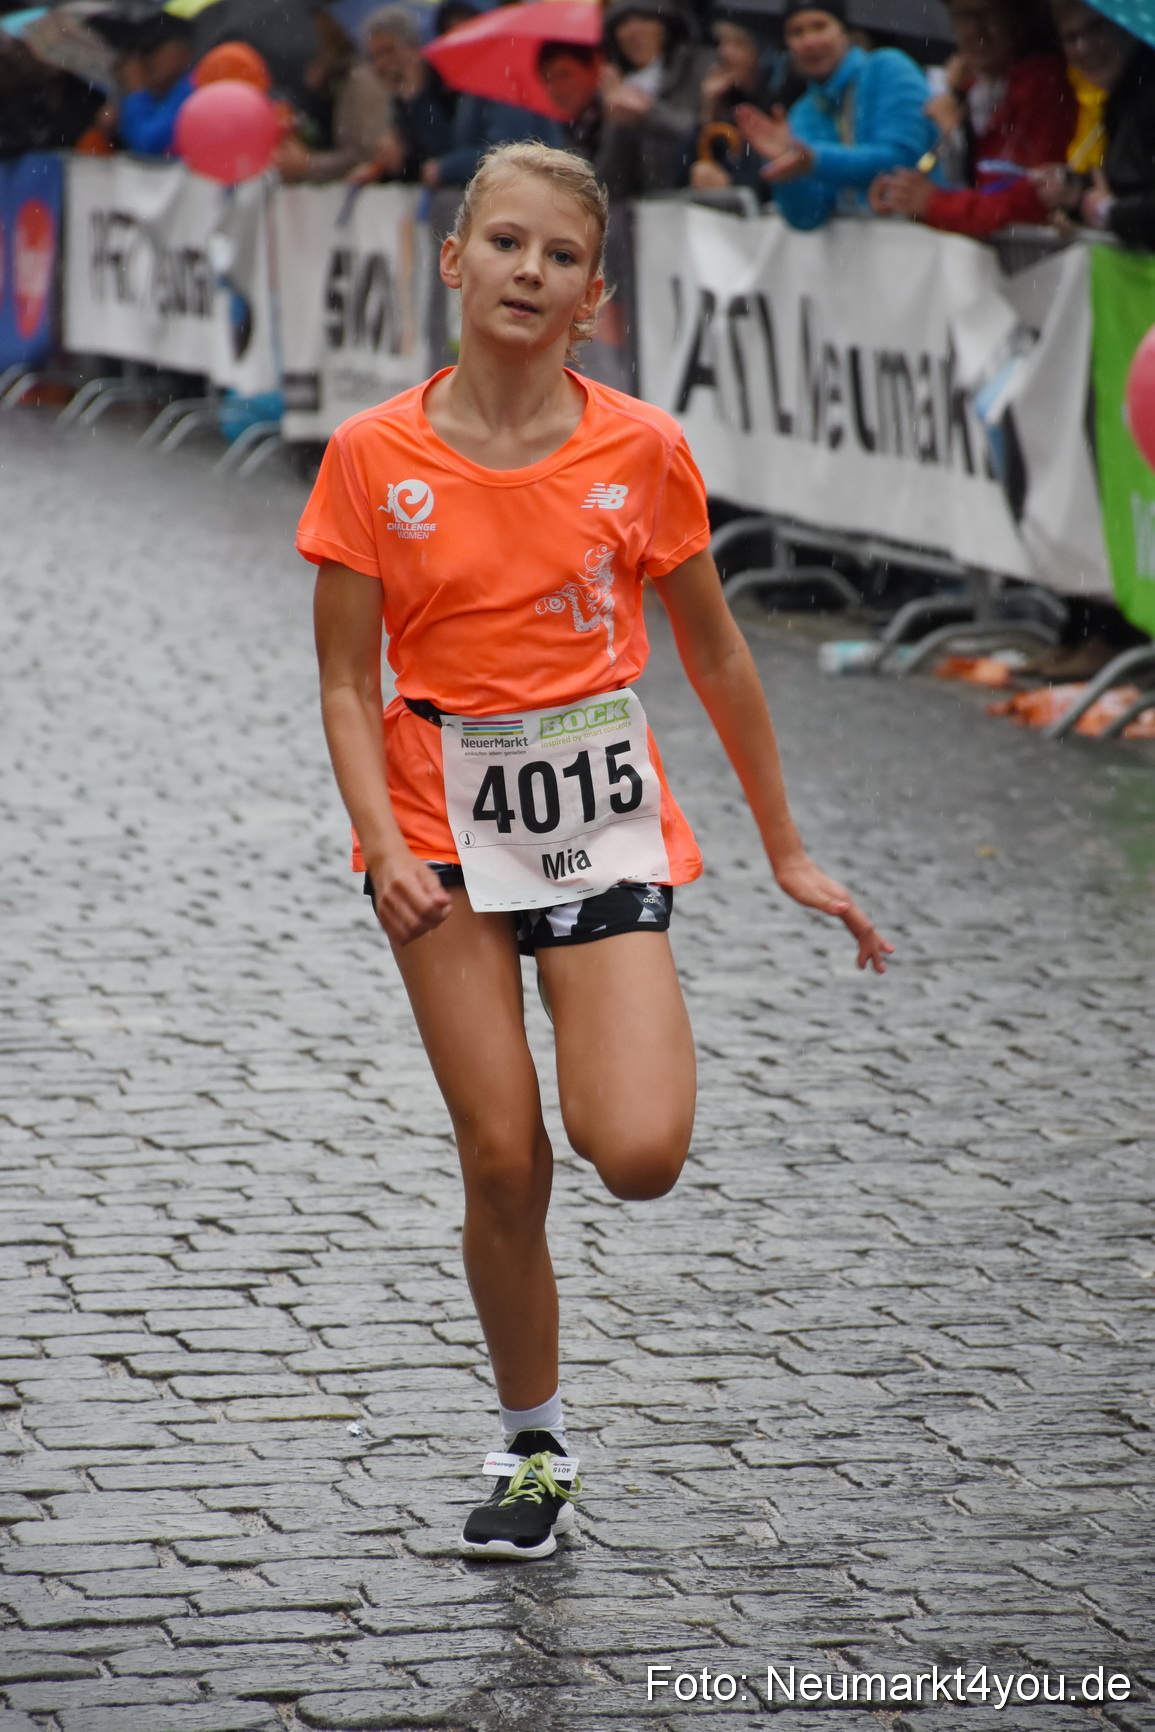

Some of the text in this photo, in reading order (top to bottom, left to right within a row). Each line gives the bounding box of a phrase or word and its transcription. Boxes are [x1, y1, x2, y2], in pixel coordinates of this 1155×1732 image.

[387, 523, 437, 531] CHALLENGE
[398, 531, 430, 539] WOMEN
[540, 698, 631, 739] BOCK
[461, 737, 529, 748] NeuerMarkt
[540, 720, 632, 748] inspired by smart concepts
[472, 740, 643, 834] 4015
[464, 833, 471, 846] J
[541, 848, 592, 880] Mia
